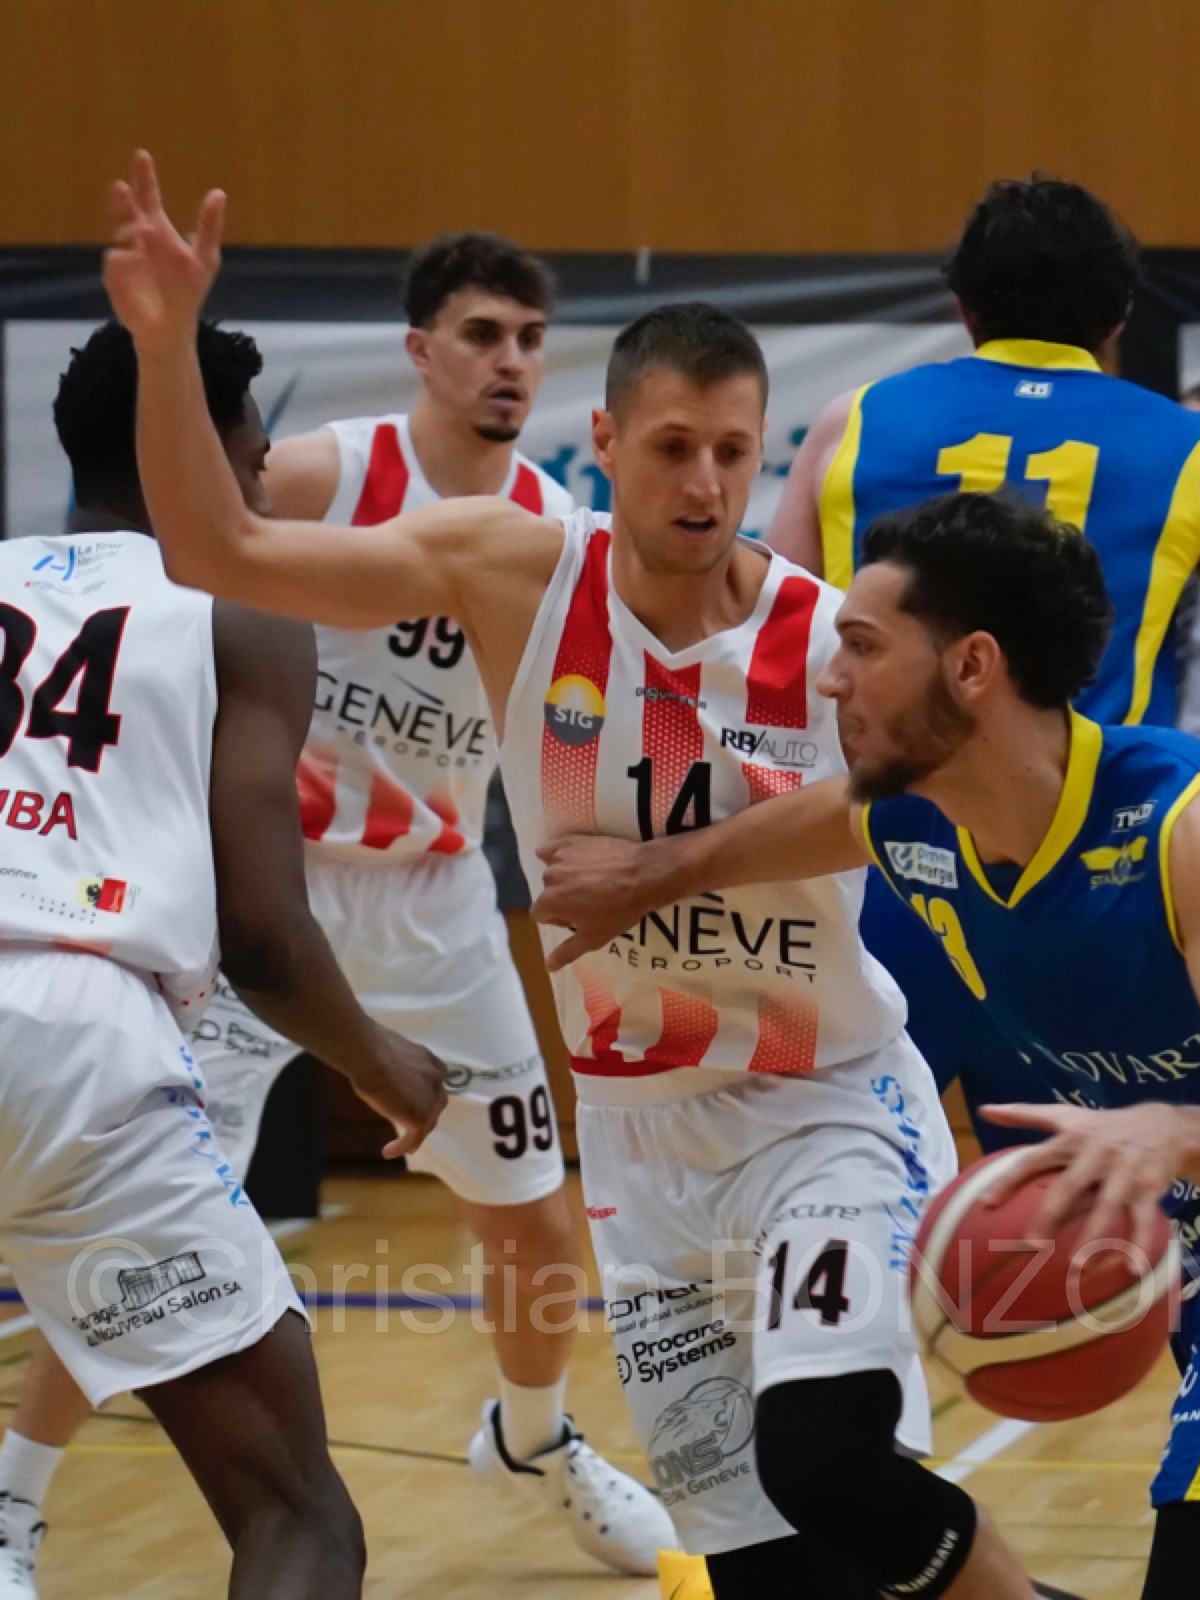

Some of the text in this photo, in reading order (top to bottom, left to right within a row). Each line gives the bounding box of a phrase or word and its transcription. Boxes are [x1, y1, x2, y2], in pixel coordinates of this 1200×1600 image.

[936, 432, 1100, 534] 11
[387, 615, 466, 670] 99
[553, 705, 594, 730] SIG
[627, 756, 713, 841] 14
[568, 891, 817, 970] NÈVE
[489, 1083, 553, 1160] 99
[167, 1285, 222, 1314] Salon
[767, 1238, 850, 1332] 14
[632, 1319, 725, 1362] Procare
[637, 1331, 737, 1383] Systems
